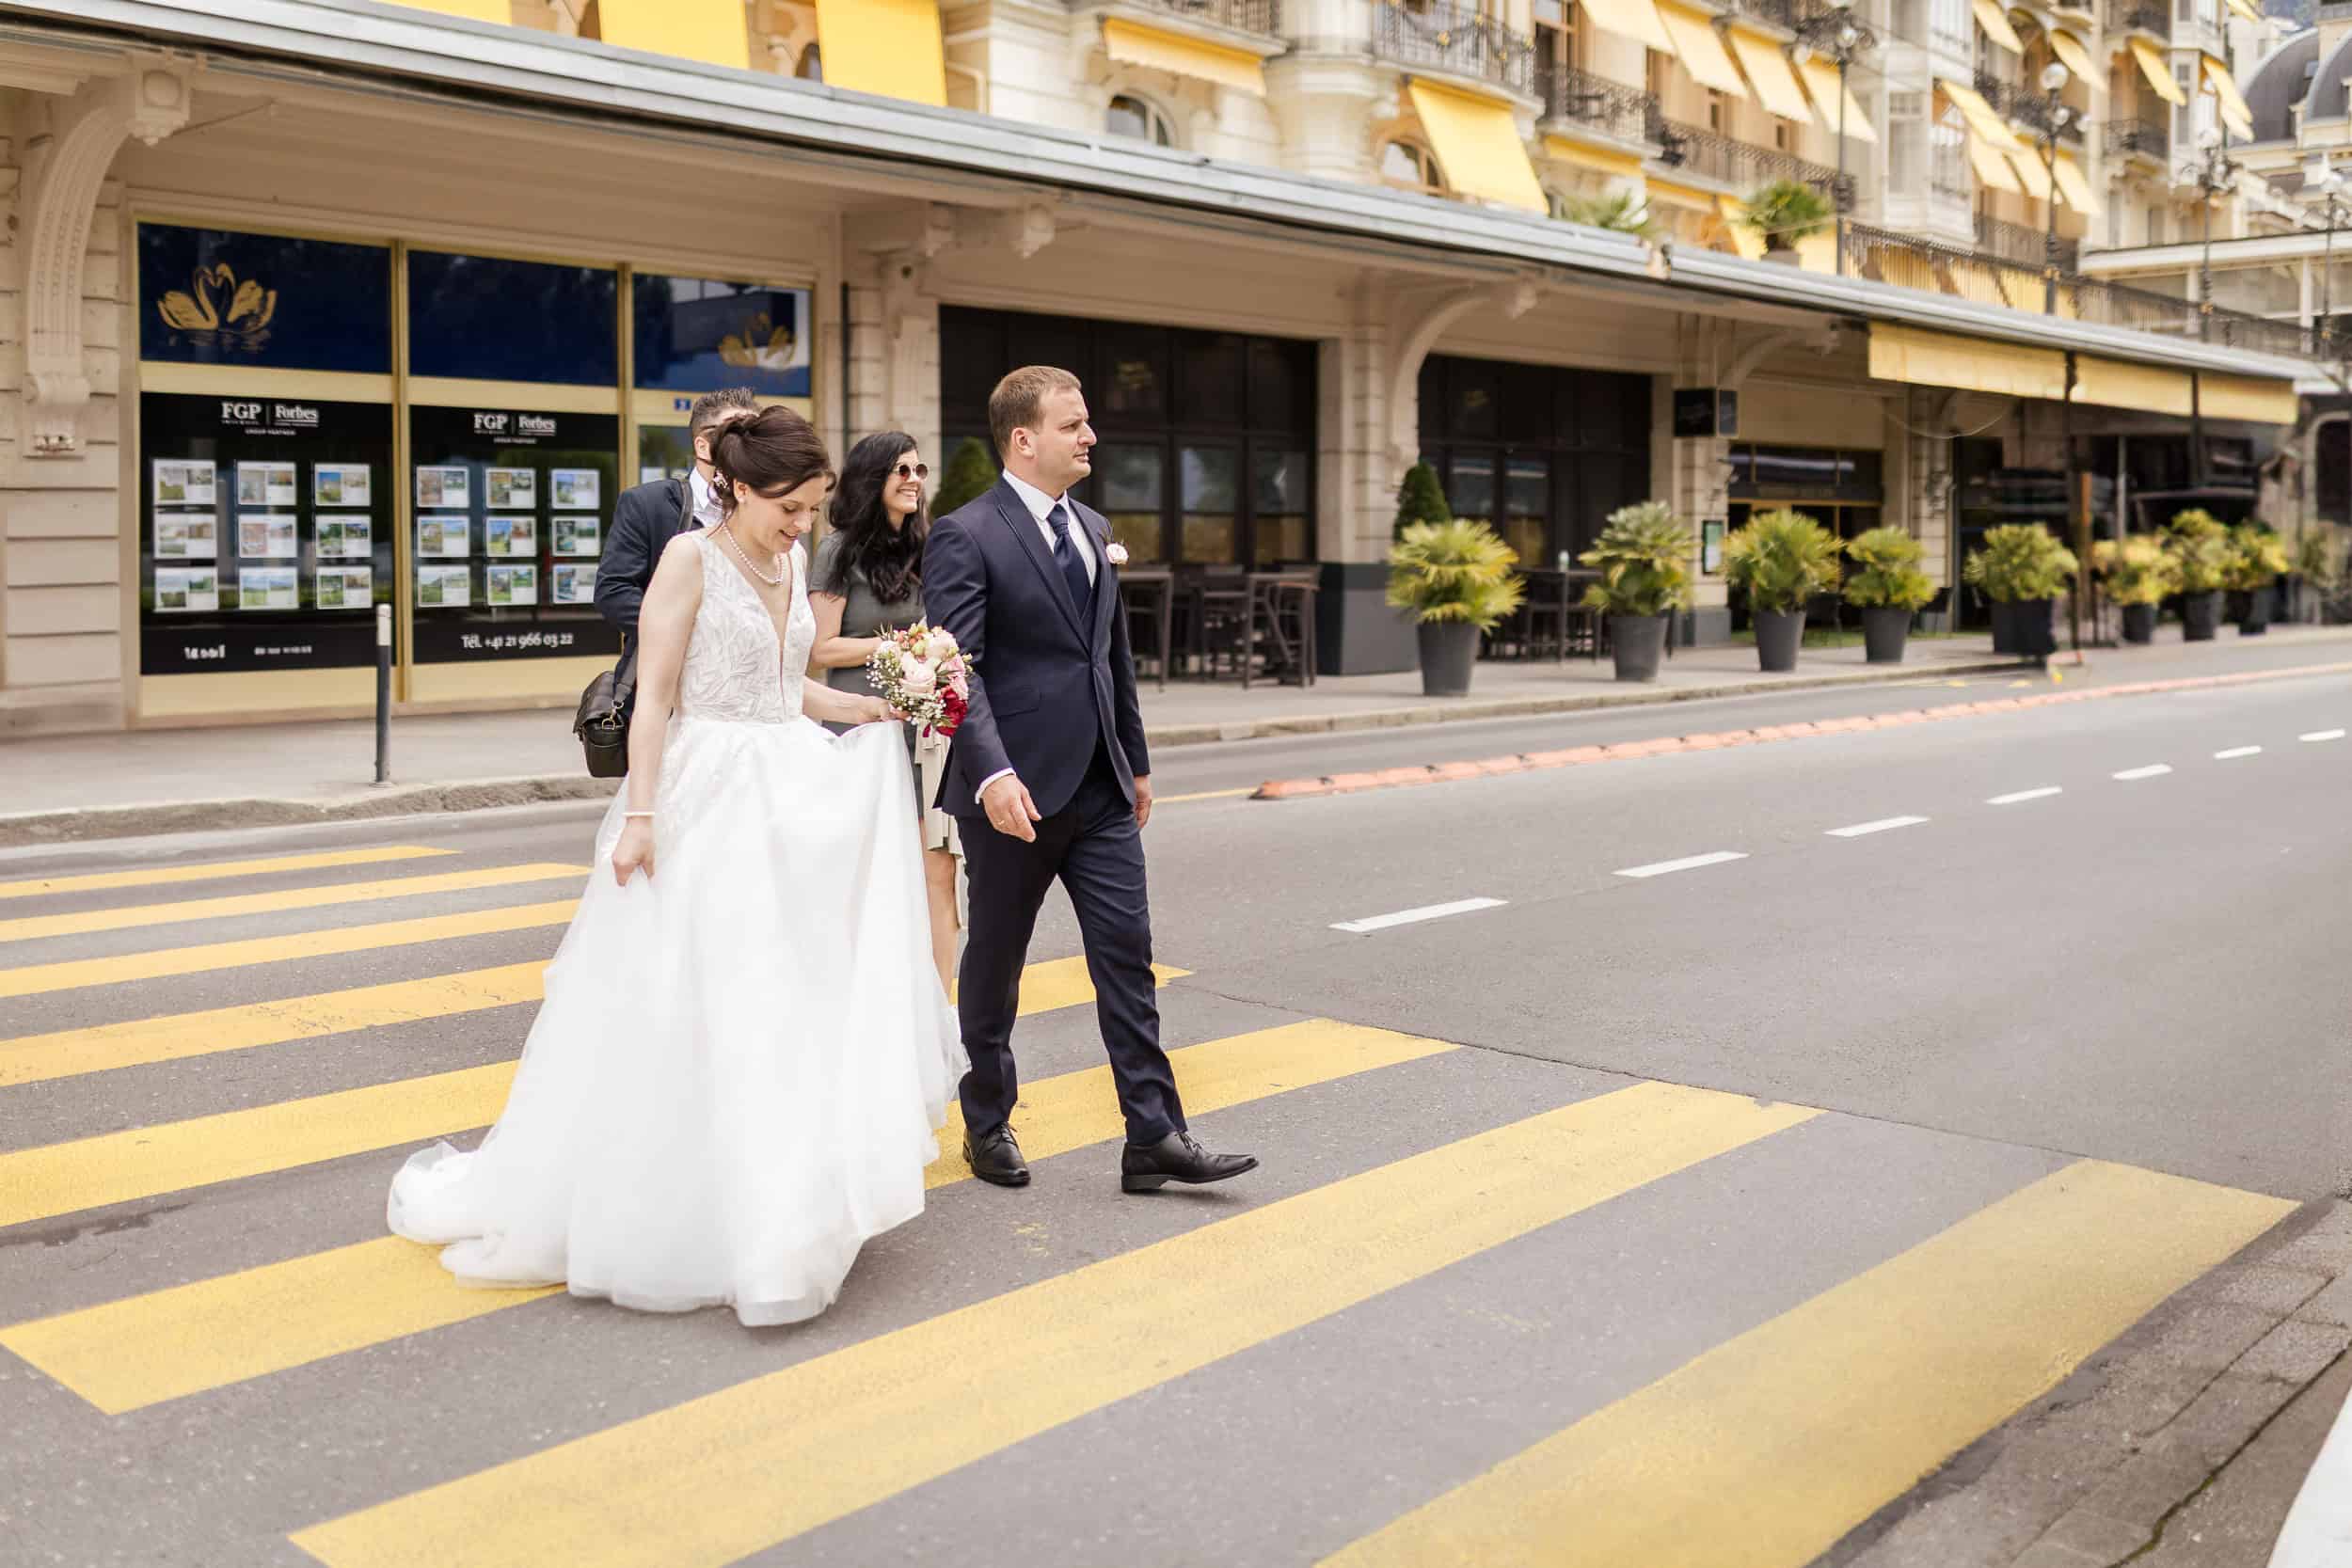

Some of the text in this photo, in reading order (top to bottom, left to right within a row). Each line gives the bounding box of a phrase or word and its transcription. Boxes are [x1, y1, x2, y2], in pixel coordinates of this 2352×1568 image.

[222, 402, 318, 420] FGP Forbes
[474, 414, 556, 429] FGP Forbes
[518, 632, 542, 649] 966
[543, 633, 558, 648] 03
